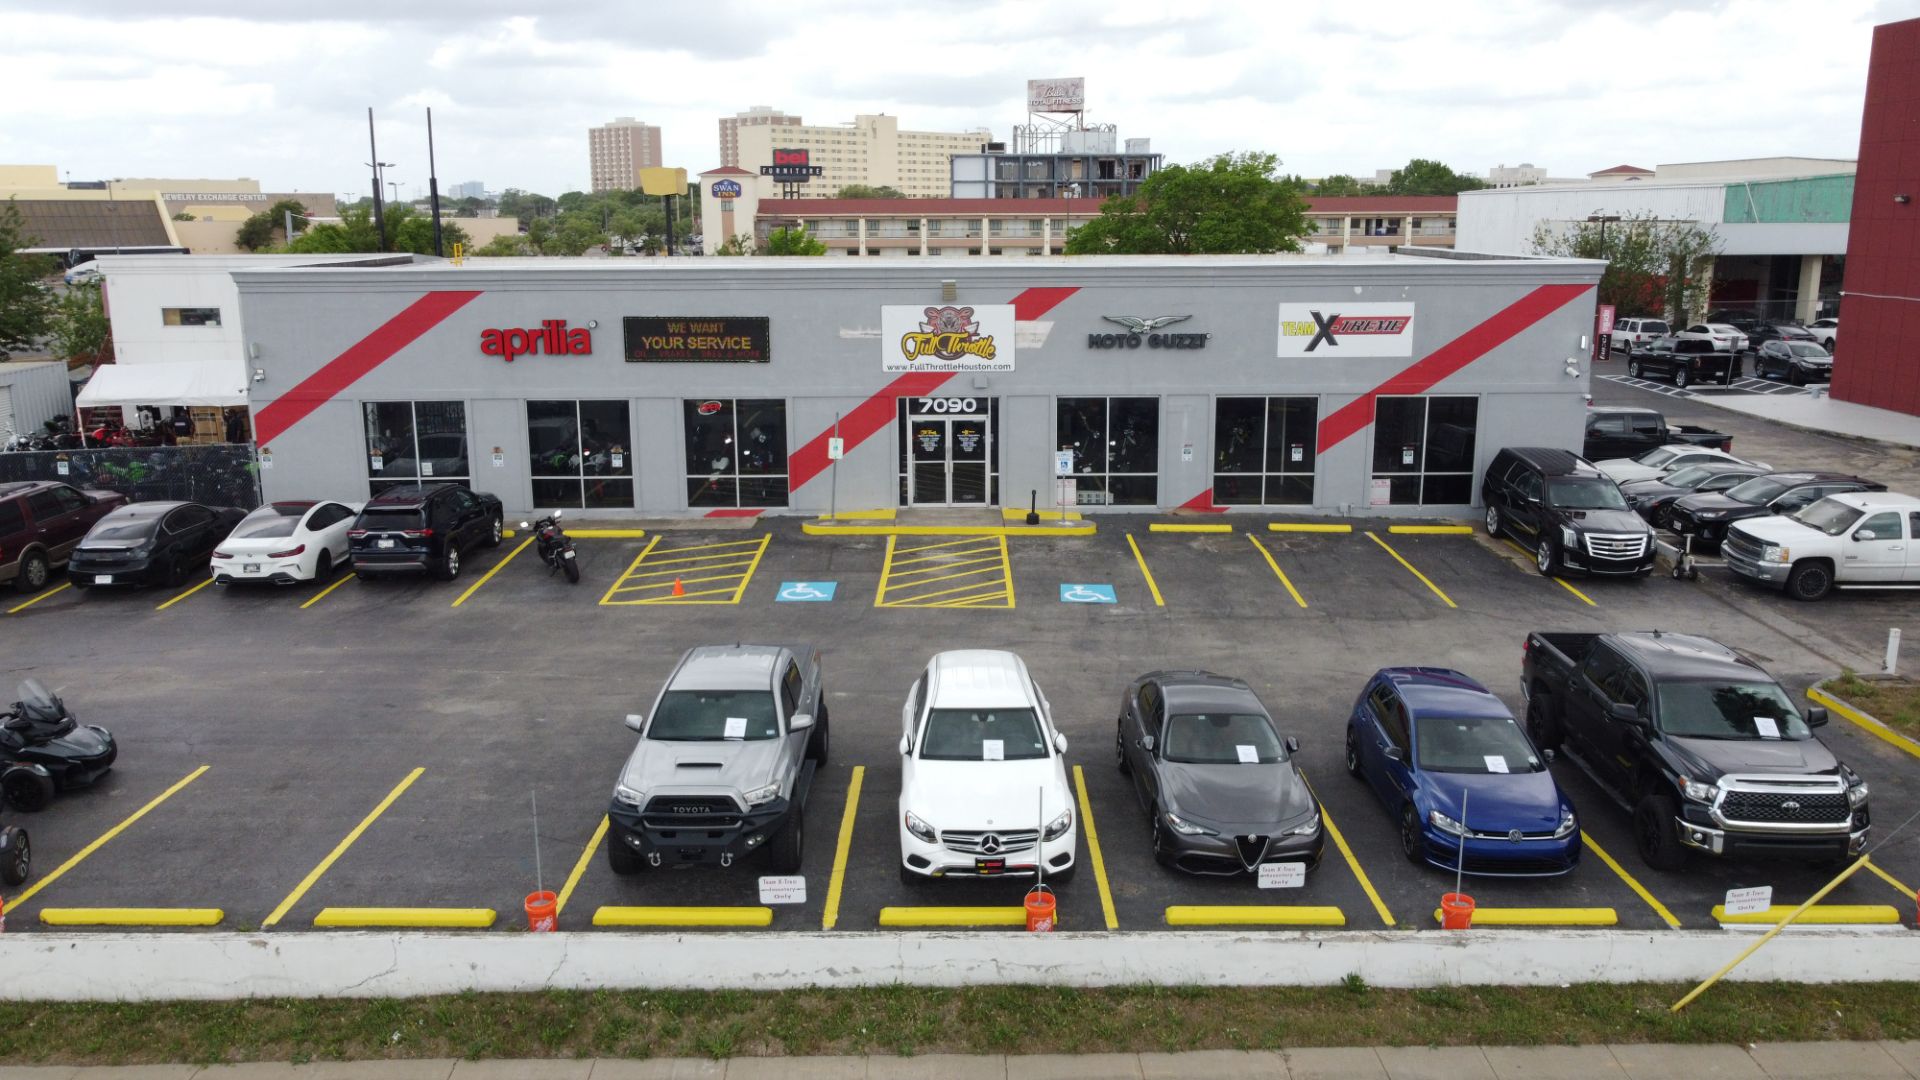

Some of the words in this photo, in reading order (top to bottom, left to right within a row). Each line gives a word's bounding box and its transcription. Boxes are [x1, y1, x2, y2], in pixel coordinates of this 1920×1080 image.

[1053, 96, 1082, 105] FITNESS
[775, 150, 807, 164] bel
[713, 184, 739, 192] SWAN
[162, 193, 196, 201] JEWELRY
[198, 193, 238, 201] EXCHANGE
[239, 193, 267, 201] CENTER
[667, 322, 687, 334] WE
[690, 322, 726, 334] WANT
[1281, 321, 1316, 336] TEAM
[480, 319, 592, 362] aprilia
[642, 336, 684, 350] YOUR
[687, 336, 752, 350] SERVICE
[901, 331, 937, 361] Full
[937, 331, 996, 360] Throttle
[1088, 333, 1141, 350] MOTO
[1148, 333, 1206, 350] GUZZI
[886, 363, 1011, 372] www.FullThrottleHouston.com
[918, 397, 977, 413] 7090
